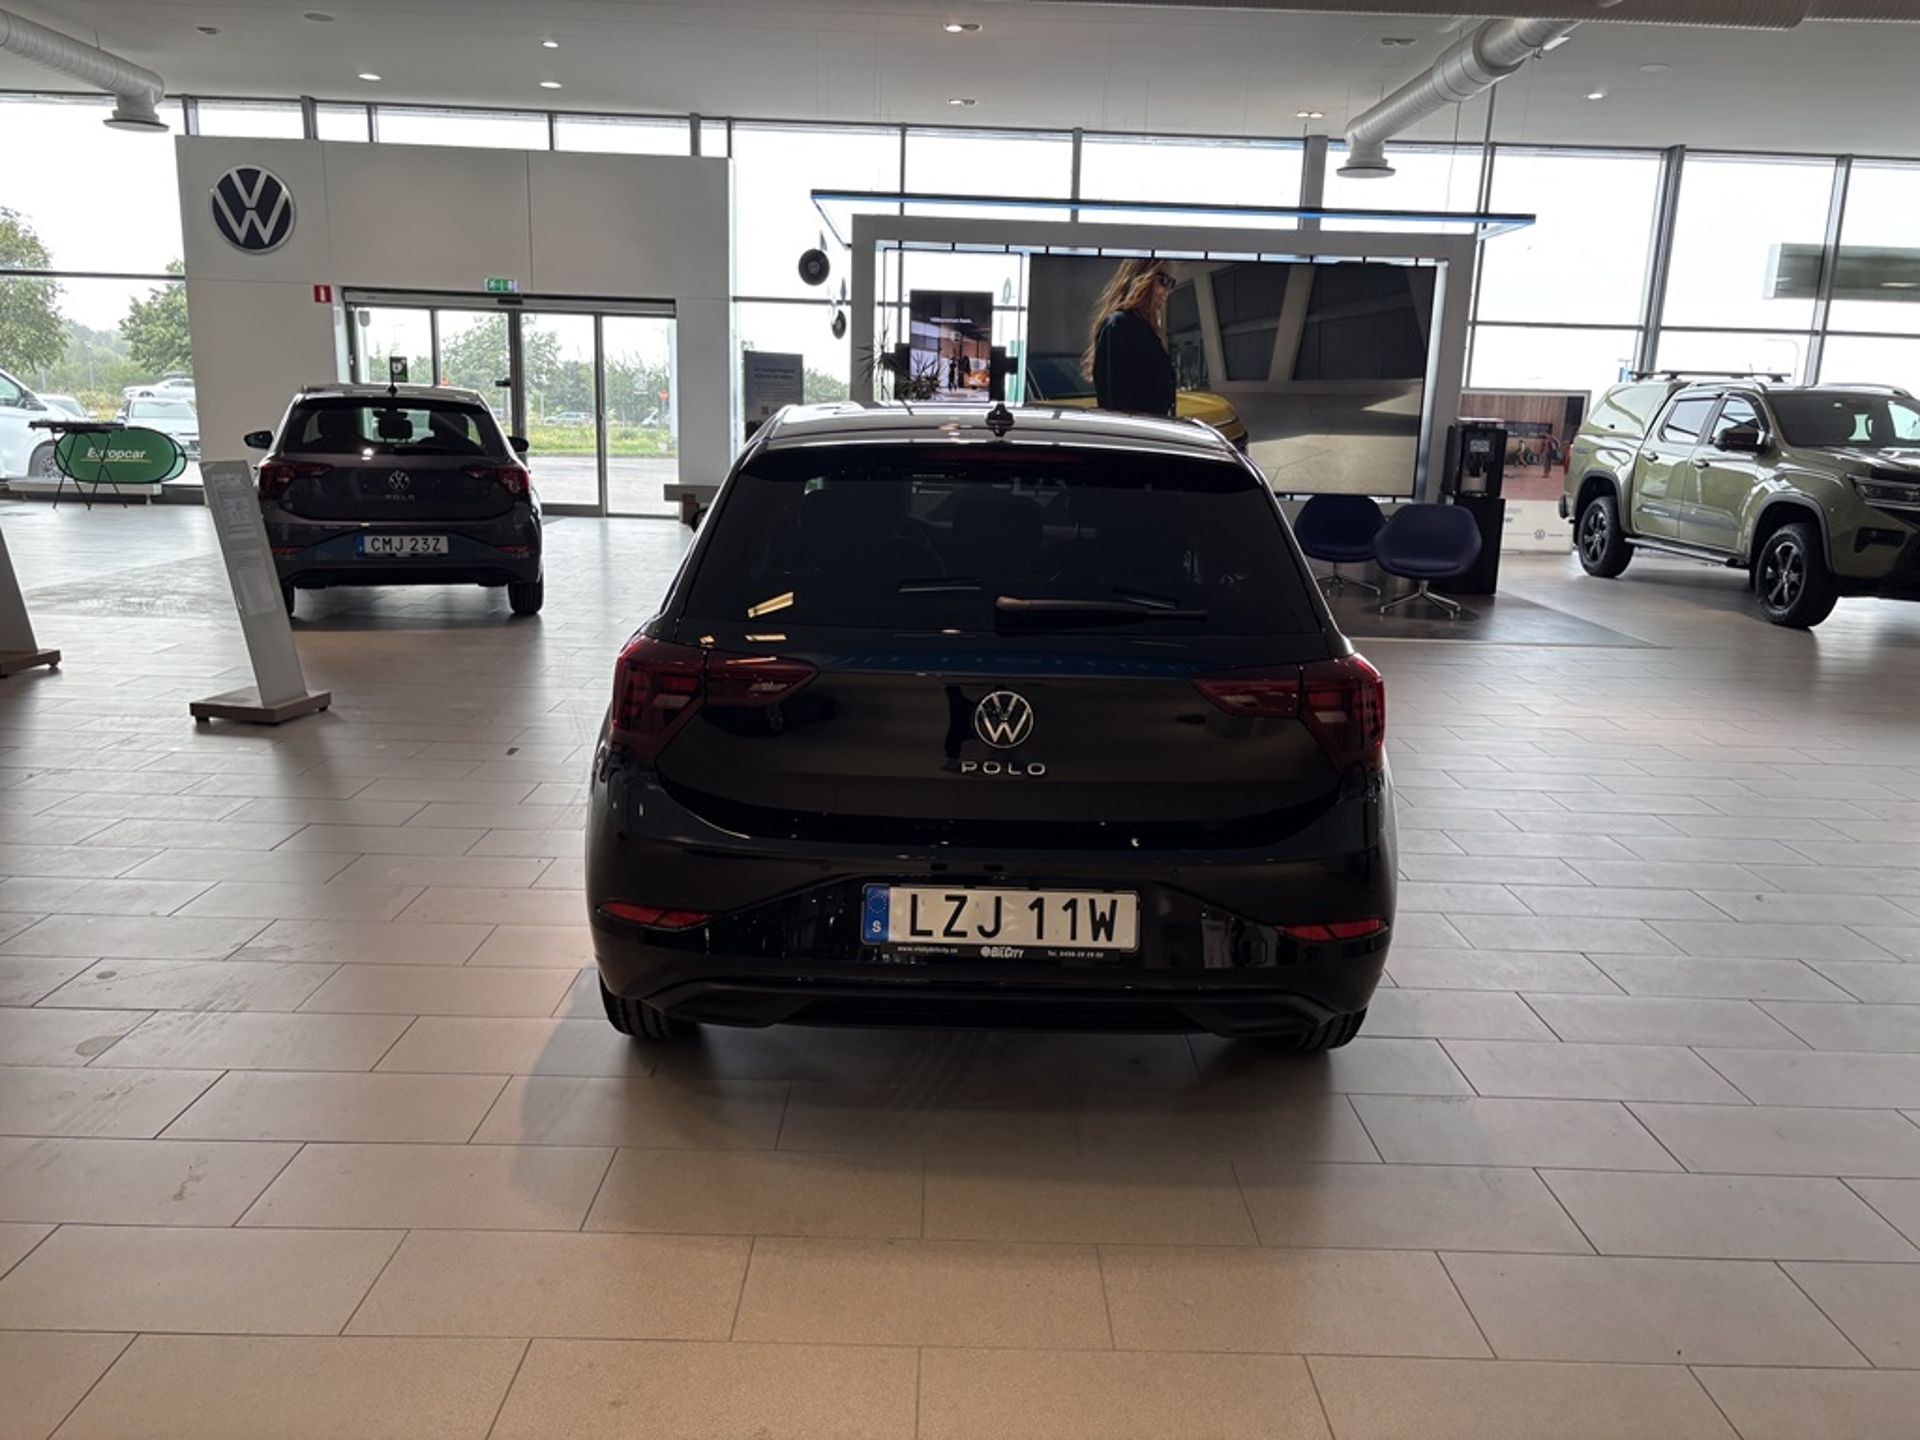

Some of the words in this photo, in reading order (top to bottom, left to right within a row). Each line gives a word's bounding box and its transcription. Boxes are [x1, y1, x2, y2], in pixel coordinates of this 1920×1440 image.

[371, 537, 404, 552] CMJ
[409, 537, 441, 552] 23Z
[961, 761, 1046, 775] POLO
[910, 894, 1002, 938] LZJ
[1028, 897, 1118, 942] 11W
[872, 920, 881, 933] S
